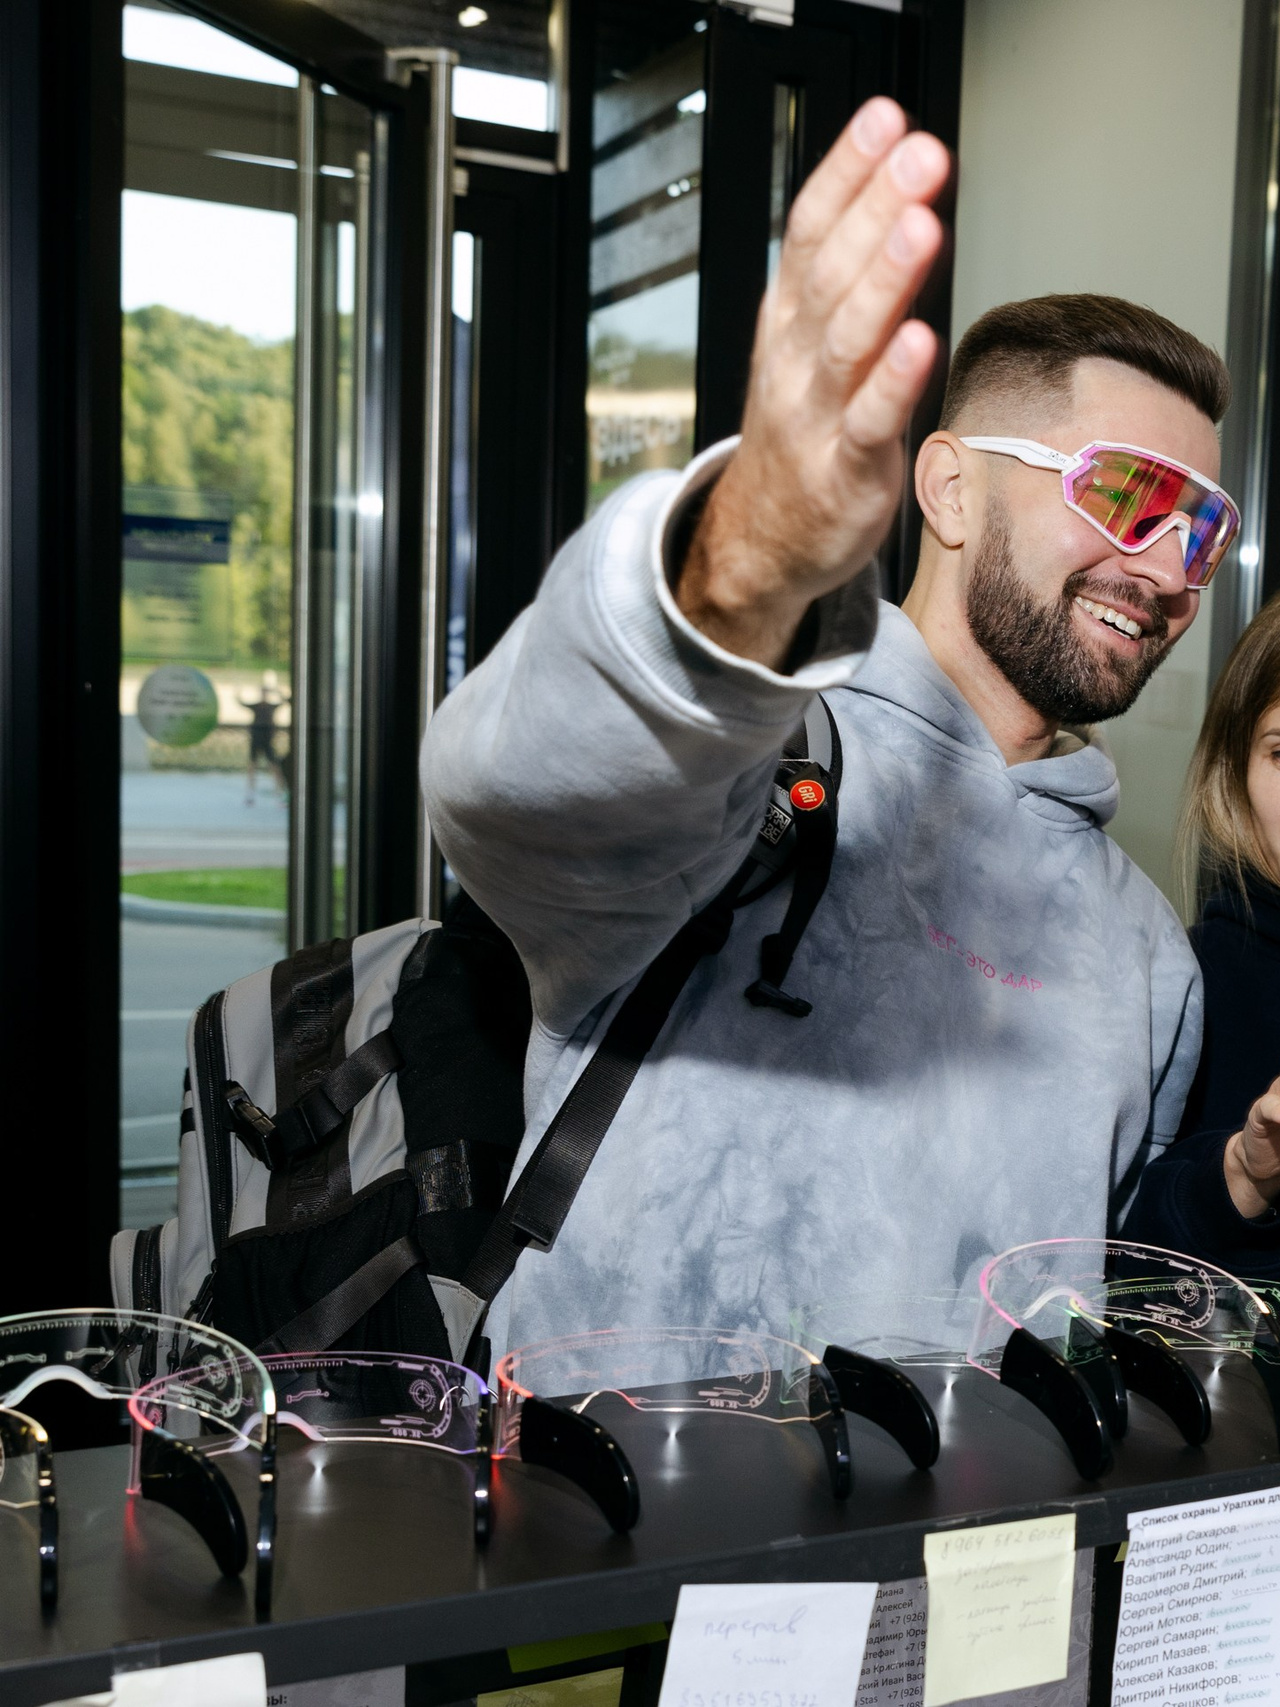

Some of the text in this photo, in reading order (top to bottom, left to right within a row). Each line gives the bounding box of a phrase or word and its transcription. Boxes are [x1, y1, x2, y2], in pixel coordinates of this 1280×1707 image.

[966, 951, 996, 979] ЭТО
[1000, 972, 1042, 992] ДАР
[1141, 1512, 1179, 1528] Список
[1182, 1504, 1220, 1520] охраны
[1223, 1496, 1266, 1513] Уралхим
[1129, 1532, 1183, 1554] Дмитрий
[1185, 1523, 1241, 1543] Сахаров;
[1127, 1547, 1192, 1569] Александр
[1195, 1540, 1232, 1557] Юдин;
[1125, 1559, 1218, 1585] Василий Рудик;
[876, 1582, 928, 1599] Диана +7
[1123, 1570, 1247, 1604] Водомеров Дмитрий;
[876, 1600, 913, 1613] Алексей
[1121, 1590, 1222, 1622] Сергей Смирнов;
[870, 1612, 925, 1630] ий +7 (926)
[1119, 1611, 1203, 1639] Юрий Мотков;
[904, 1643, 915, 1652] +7
[1117, 1624, 1219, 1656] Сергей Самарин;
[860, 1666, 871, 1676] ва
[873, 1658, 915, 1674] Кристина
[1115, 1643, 1211, 1672] Кирилл Мазаев;
[857, 1678, 880, 1691] ский
[881, 1675, 904, 1686] Иван
[1113, 1659, 1219, 1690] Алексей Казаков;
[860, 1686, 923, 1705] Stas +7 (926)
[1113, 1672, 1242, 1707] Дмитрий Никифоров;
